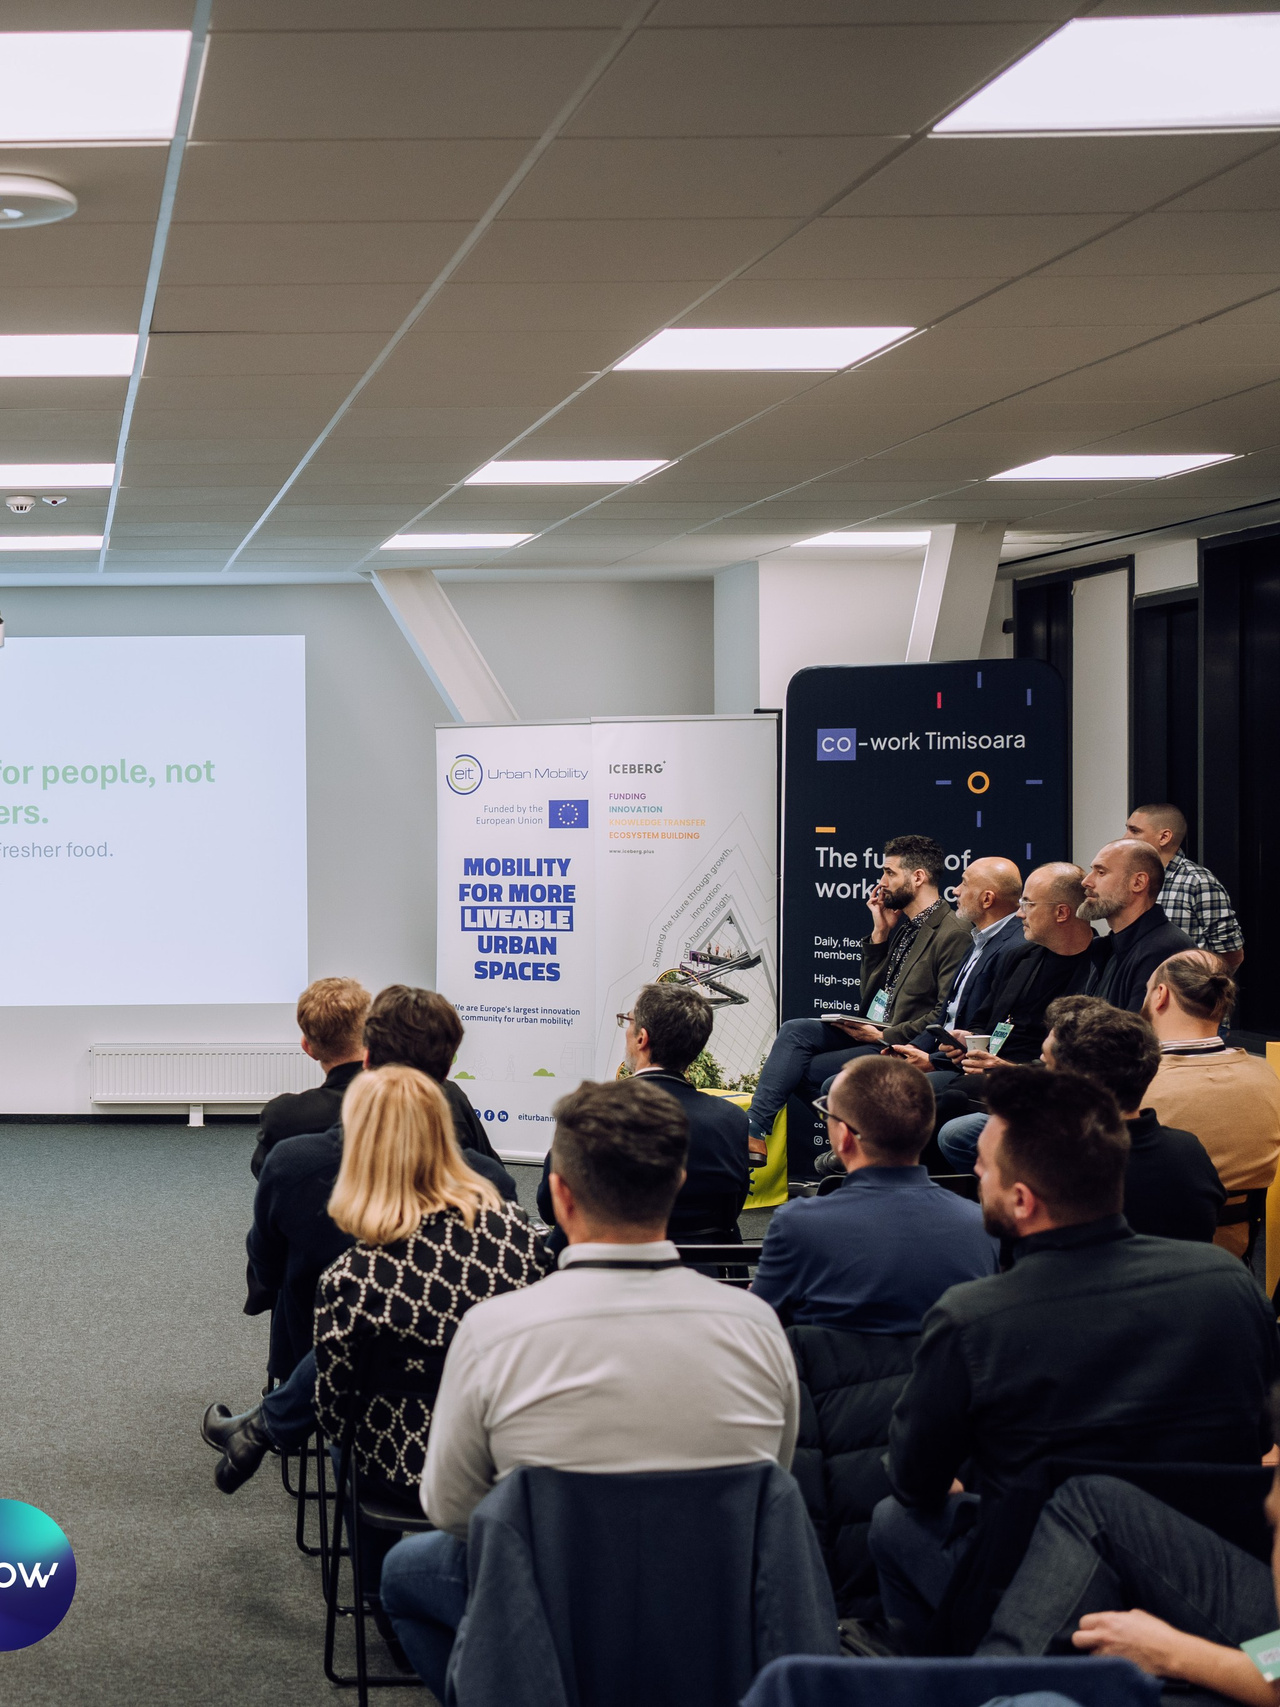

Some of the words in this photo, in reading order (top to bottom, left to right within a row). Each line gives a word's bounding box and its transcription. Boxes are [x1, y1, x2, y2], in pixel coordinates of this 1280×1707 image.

[924, 731, 1026, 750] Timisoara
[41, 758, 156, 791] people,
[165, 759, 216, 784] not
[454, 767, 474, 780] eit
[487, 768, 532, 780] Urban
[534, 767, 589, 781] Mobility
[608, 792, 647, 800] FUNDING
[483, 804, 515, 813] Funded
[516, 804, 527, 815] by
[529, 804, 544, 813] the
[608, 805, 663, 813] INNOVATION
[475, 816, 516, 826] European
[517, 816, 543, 825] Union
[608, 818, 662, 826] KNOWLEDGE
[663, 818, 706, 827] TRANSFER
[608, 831, 660, 839] ECOSYSTEM
[660, 832, 700, 840] BUILDING
[66, 841, 114, 858] food.
[815, 846, 858, 868] The
[943, 849, 972, 871] of
[463, 857, 572, 877] MOBILITY
[458, 883, 503, 902] FOR
[508, 884, 576, 903] MORE
[652, 933, 667, 968] Shaping
[661, 920, 673, 933] the
[670, 899, 689, 921] future
[687, 872, 712, 900] through
[710, 847, 734, 875] growth,
[690, 882, 722, 920] innovation
[464, 908, 571, 930] LIVEABLE
[477, 934, 557, 955] URBAN
[682, 941, 691, 960] and
[688, 916, 712, 943] human
[814, 935, 841, 949] Daily,
[842, 937, 864, 948] flexi
[474, 960, 561, 982] SPACES
[813, 973, 861, 987] High-spe
[479, 1004, 512, 1014] Europe's
[512, 1005, 539, 1015] largest
[540, 1006, 581, 1016] innovation
[813, 998, 852, 1011] Flexible
[461, 1014, 503, 1024] community
[504, 1015, 515, 1023] for
[516, 1016, 538, 1024] urban
[539, 1017, 573, 1027] mobility!
